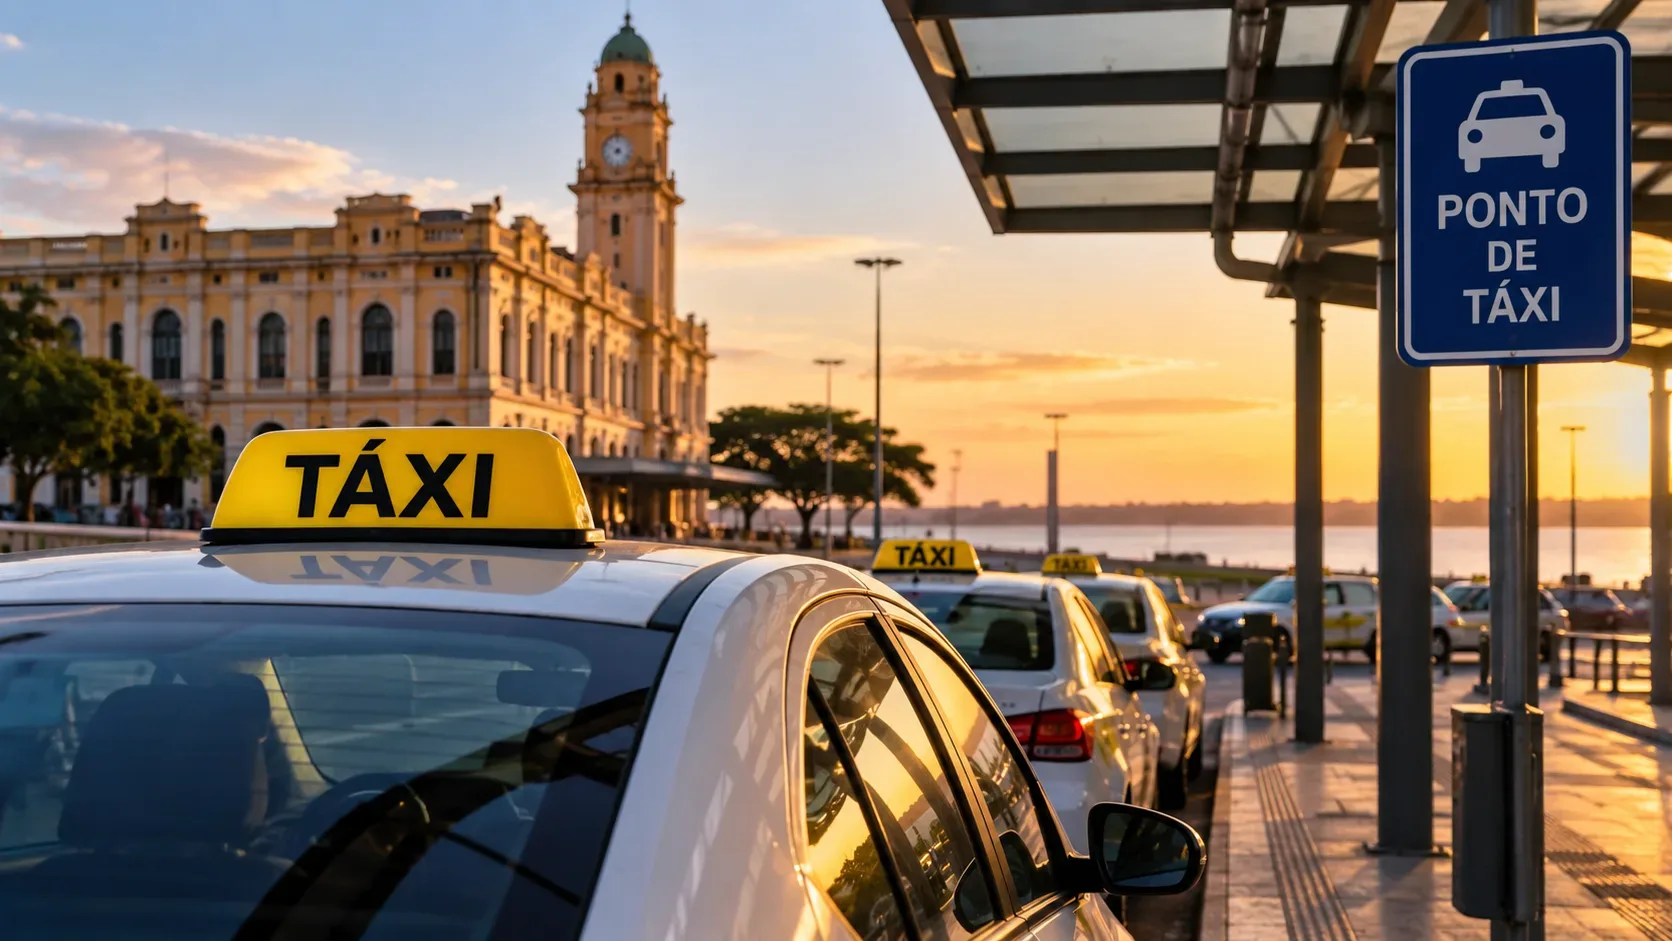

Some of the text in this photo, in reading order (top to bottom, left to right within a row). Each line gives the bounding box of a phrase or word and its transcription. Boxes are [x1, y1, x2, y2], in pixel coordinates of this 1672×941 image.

[1437, 187, 1588, 230] PONTO
[1487, 239, 1537, 272] DE
[1463, 279, 1560, 324] TÁXI
[284, 438, 495, 518] TÁXI
[894, 542, 955, 566] TÁXI
